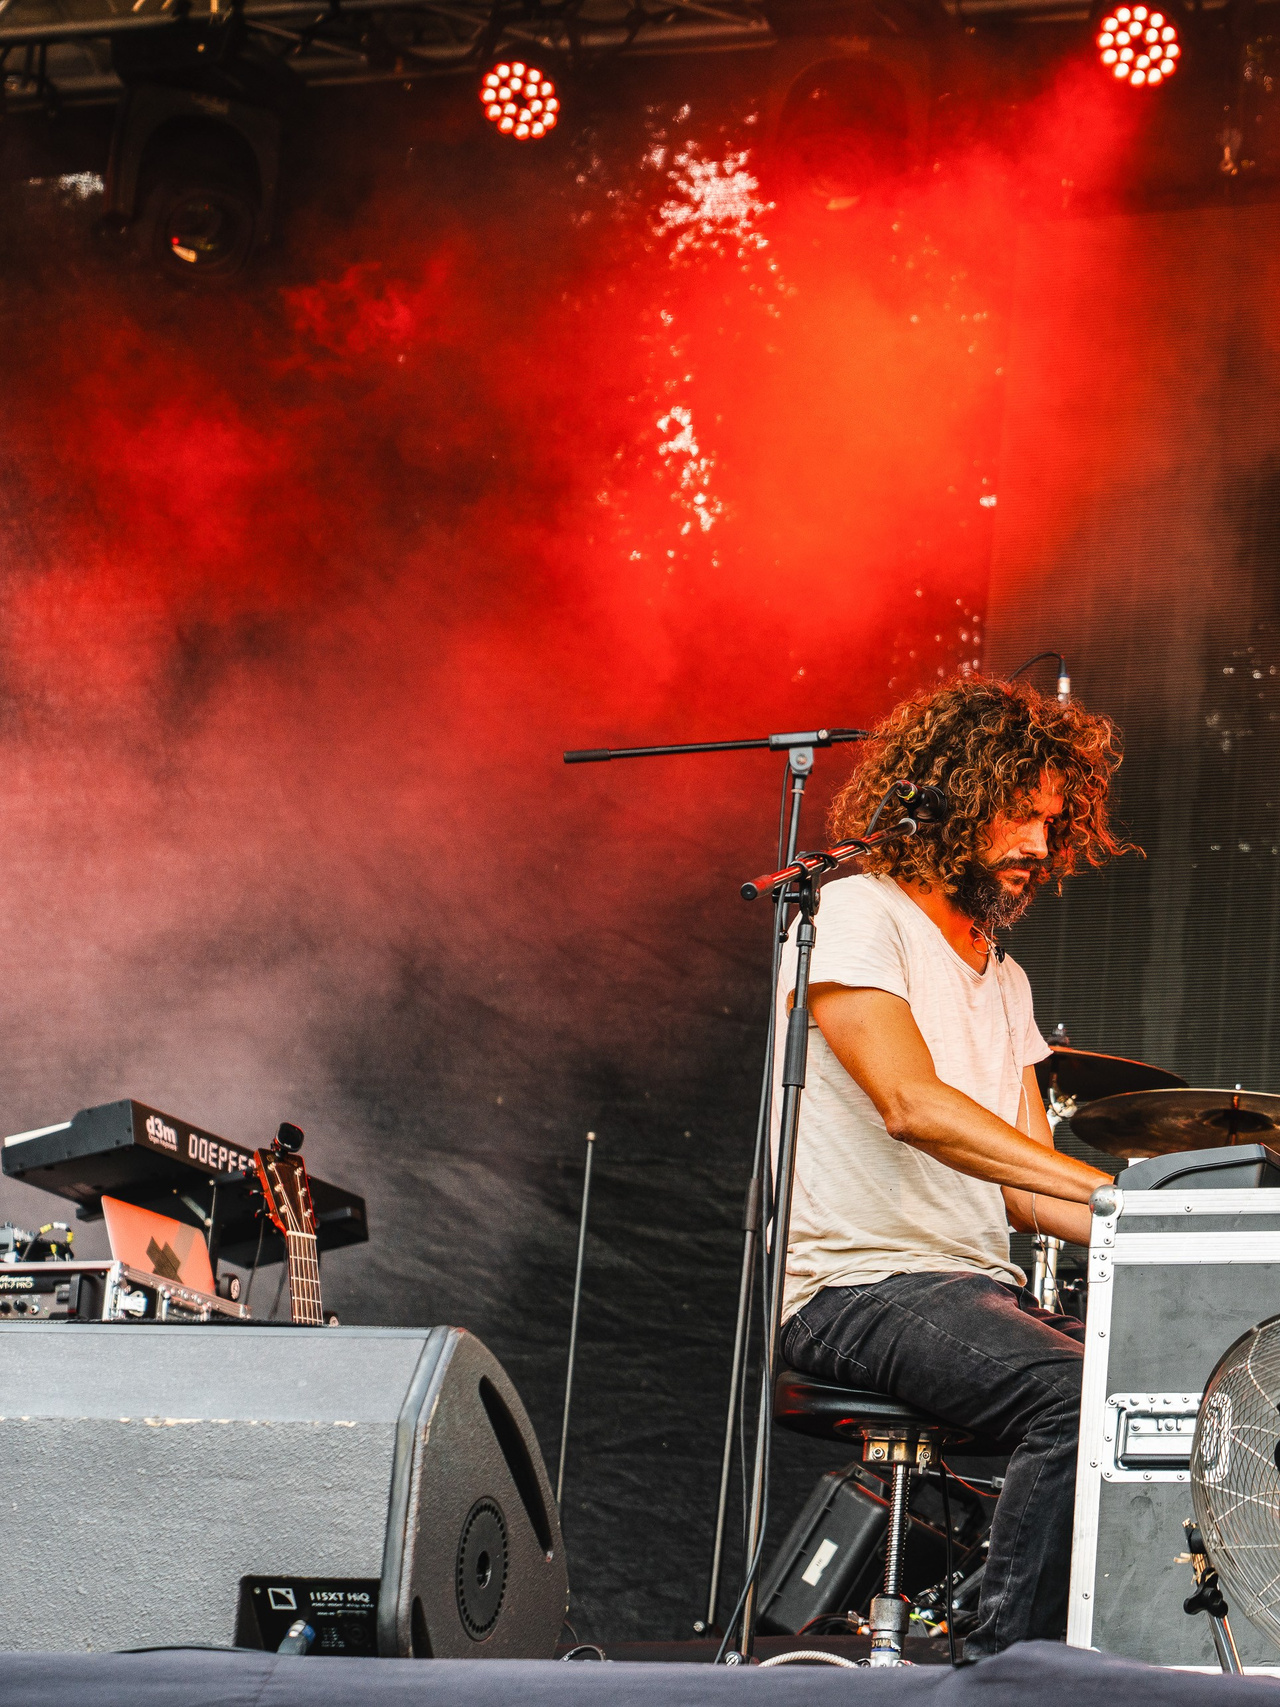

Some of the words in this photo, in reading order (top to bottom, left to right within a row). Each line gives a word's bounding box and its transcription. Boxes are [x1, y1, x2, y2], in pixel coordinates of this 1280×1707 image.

[145, 1115, 177, 1145] d3m
[309, 1591, 344, 1601] 115XT
[346, 1592, 371, 1603] HiQ
